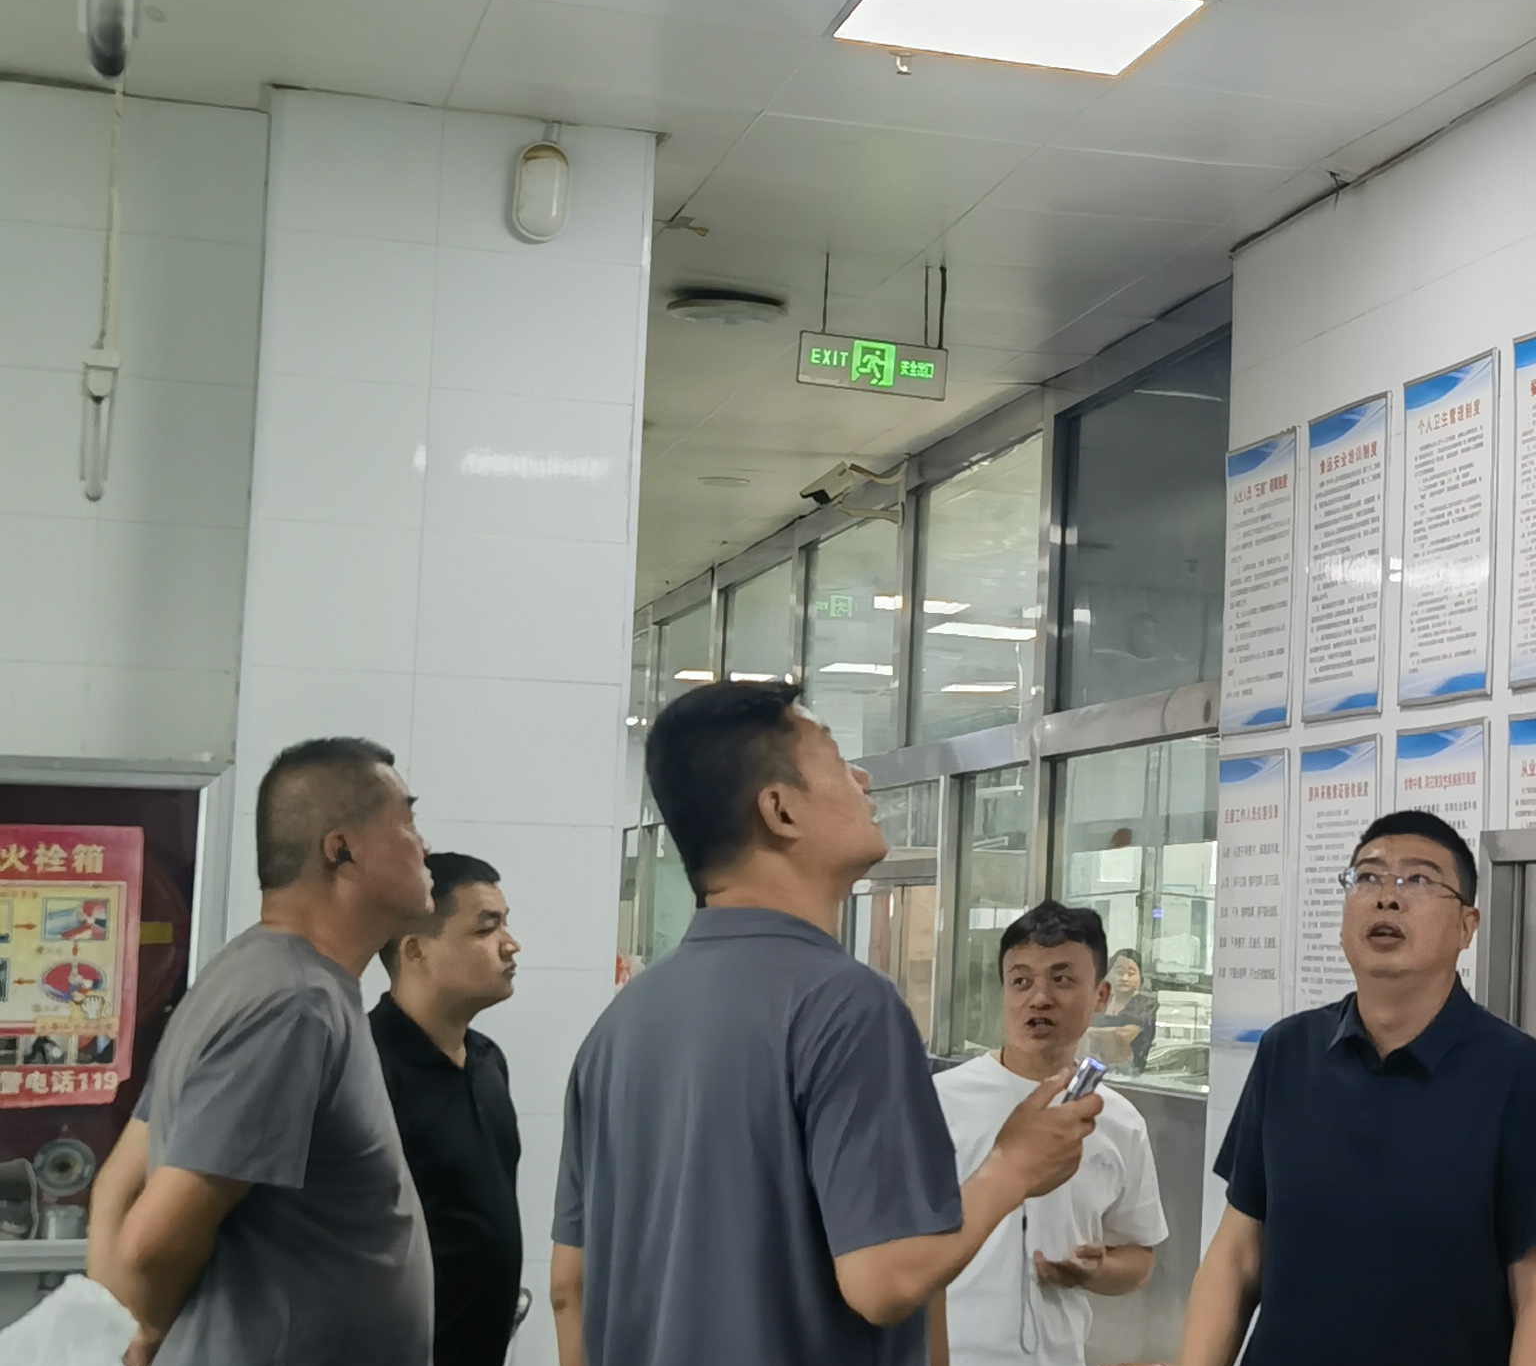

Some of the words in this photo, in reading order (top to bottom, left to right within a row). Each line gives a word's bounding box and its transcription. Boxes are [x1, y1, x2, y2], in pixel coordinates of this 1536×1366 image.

[810, 347, 850, 368] EXIT
[1417, 398, 1481, 436] 个人卫生管理制度
[0, 841, 105, 874] 火栓箱
